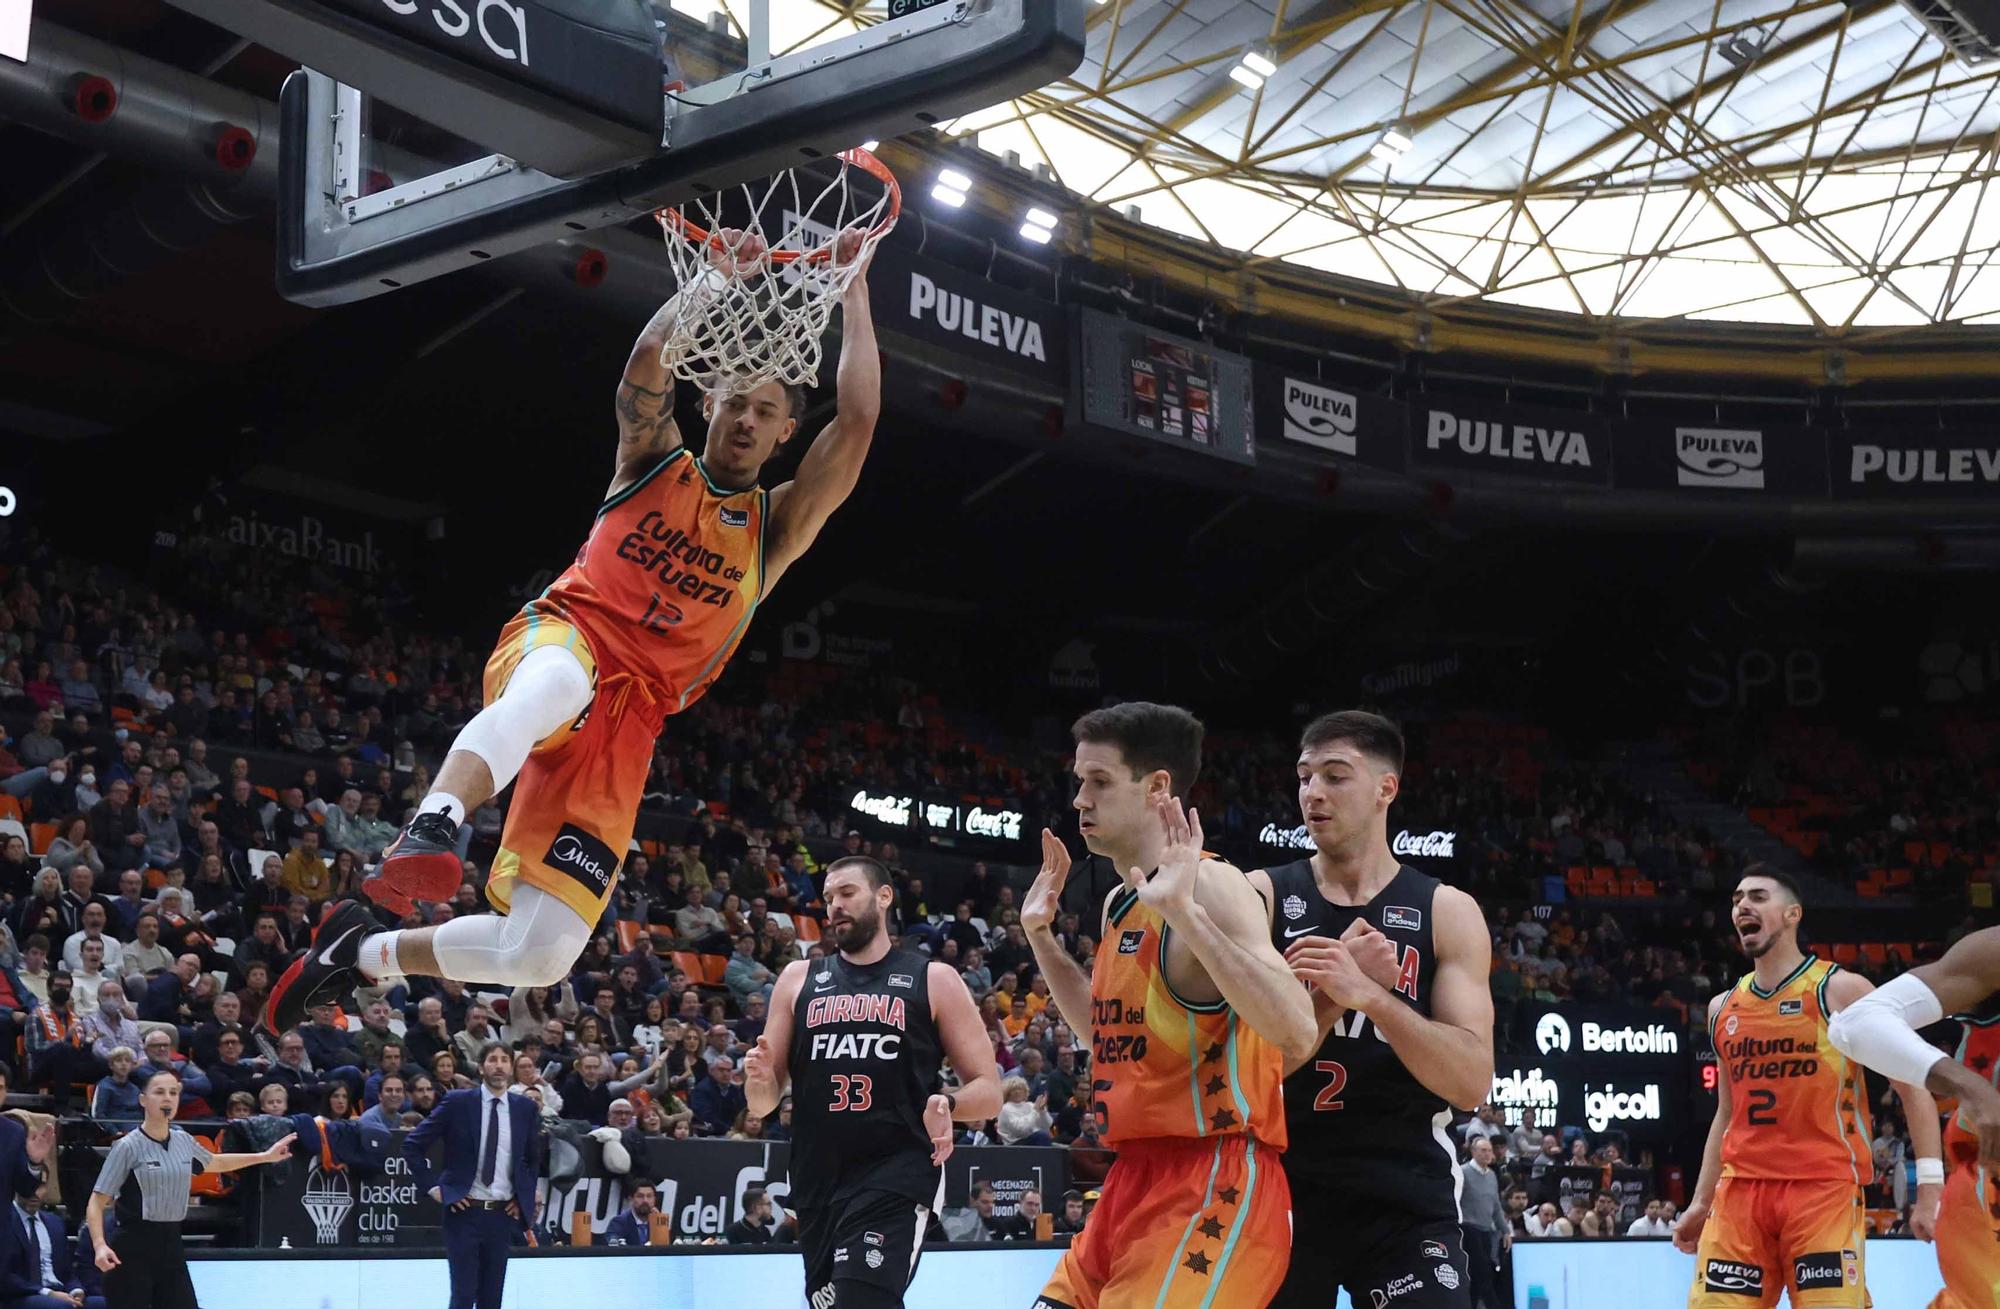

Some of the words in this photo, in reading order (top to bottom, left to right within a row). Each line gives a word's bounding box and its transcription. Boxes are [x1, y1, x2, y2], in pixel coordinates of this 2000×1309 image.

[910, 272, 1046, 362] PULEVA
[1288, 386, 1353, 419] PULEVA
[1427, 410, 1591, 466] PULEVA
[1681, 435, 1758, 454] PULEVA
[226, 509, 383, 573] aixaBank
[639, 592, 684, 636] 12
[1687, 648, 1826, 708] SPB
[560, 847, 610, 888] Midea
[1532, 905, 1552, 919] 107
[806, 993, 905, 1031] GIRONA
[1126, 1007, 1144, 1024] del
[811, 1033, 901, 1060] FIATC
[1581, 1022, 1678, 1054] Bertolín
[1723, 1036, 1795, 1060] Cultura
[1797, 1042, 1817, 1054] del
[829, 1074, 873, 1111] 33
[1314, 1060, 1347, 1111] 2
[1703, 1066, 1720, 1088] 9
[1747, 1089, 1777, 1126] 2
[360, 1179, 418, 1204] basket
[358, 1206, 398, 1231] club
[681, 1195, 726, 1233] del
[1386, 1273, 1414, 1290] Kave
[1708, 1262, 1760, 1278] PULEVA
[1798, 1265, 1842, 1280] Midea
[1387, 1280, 1424, 1299] Home
